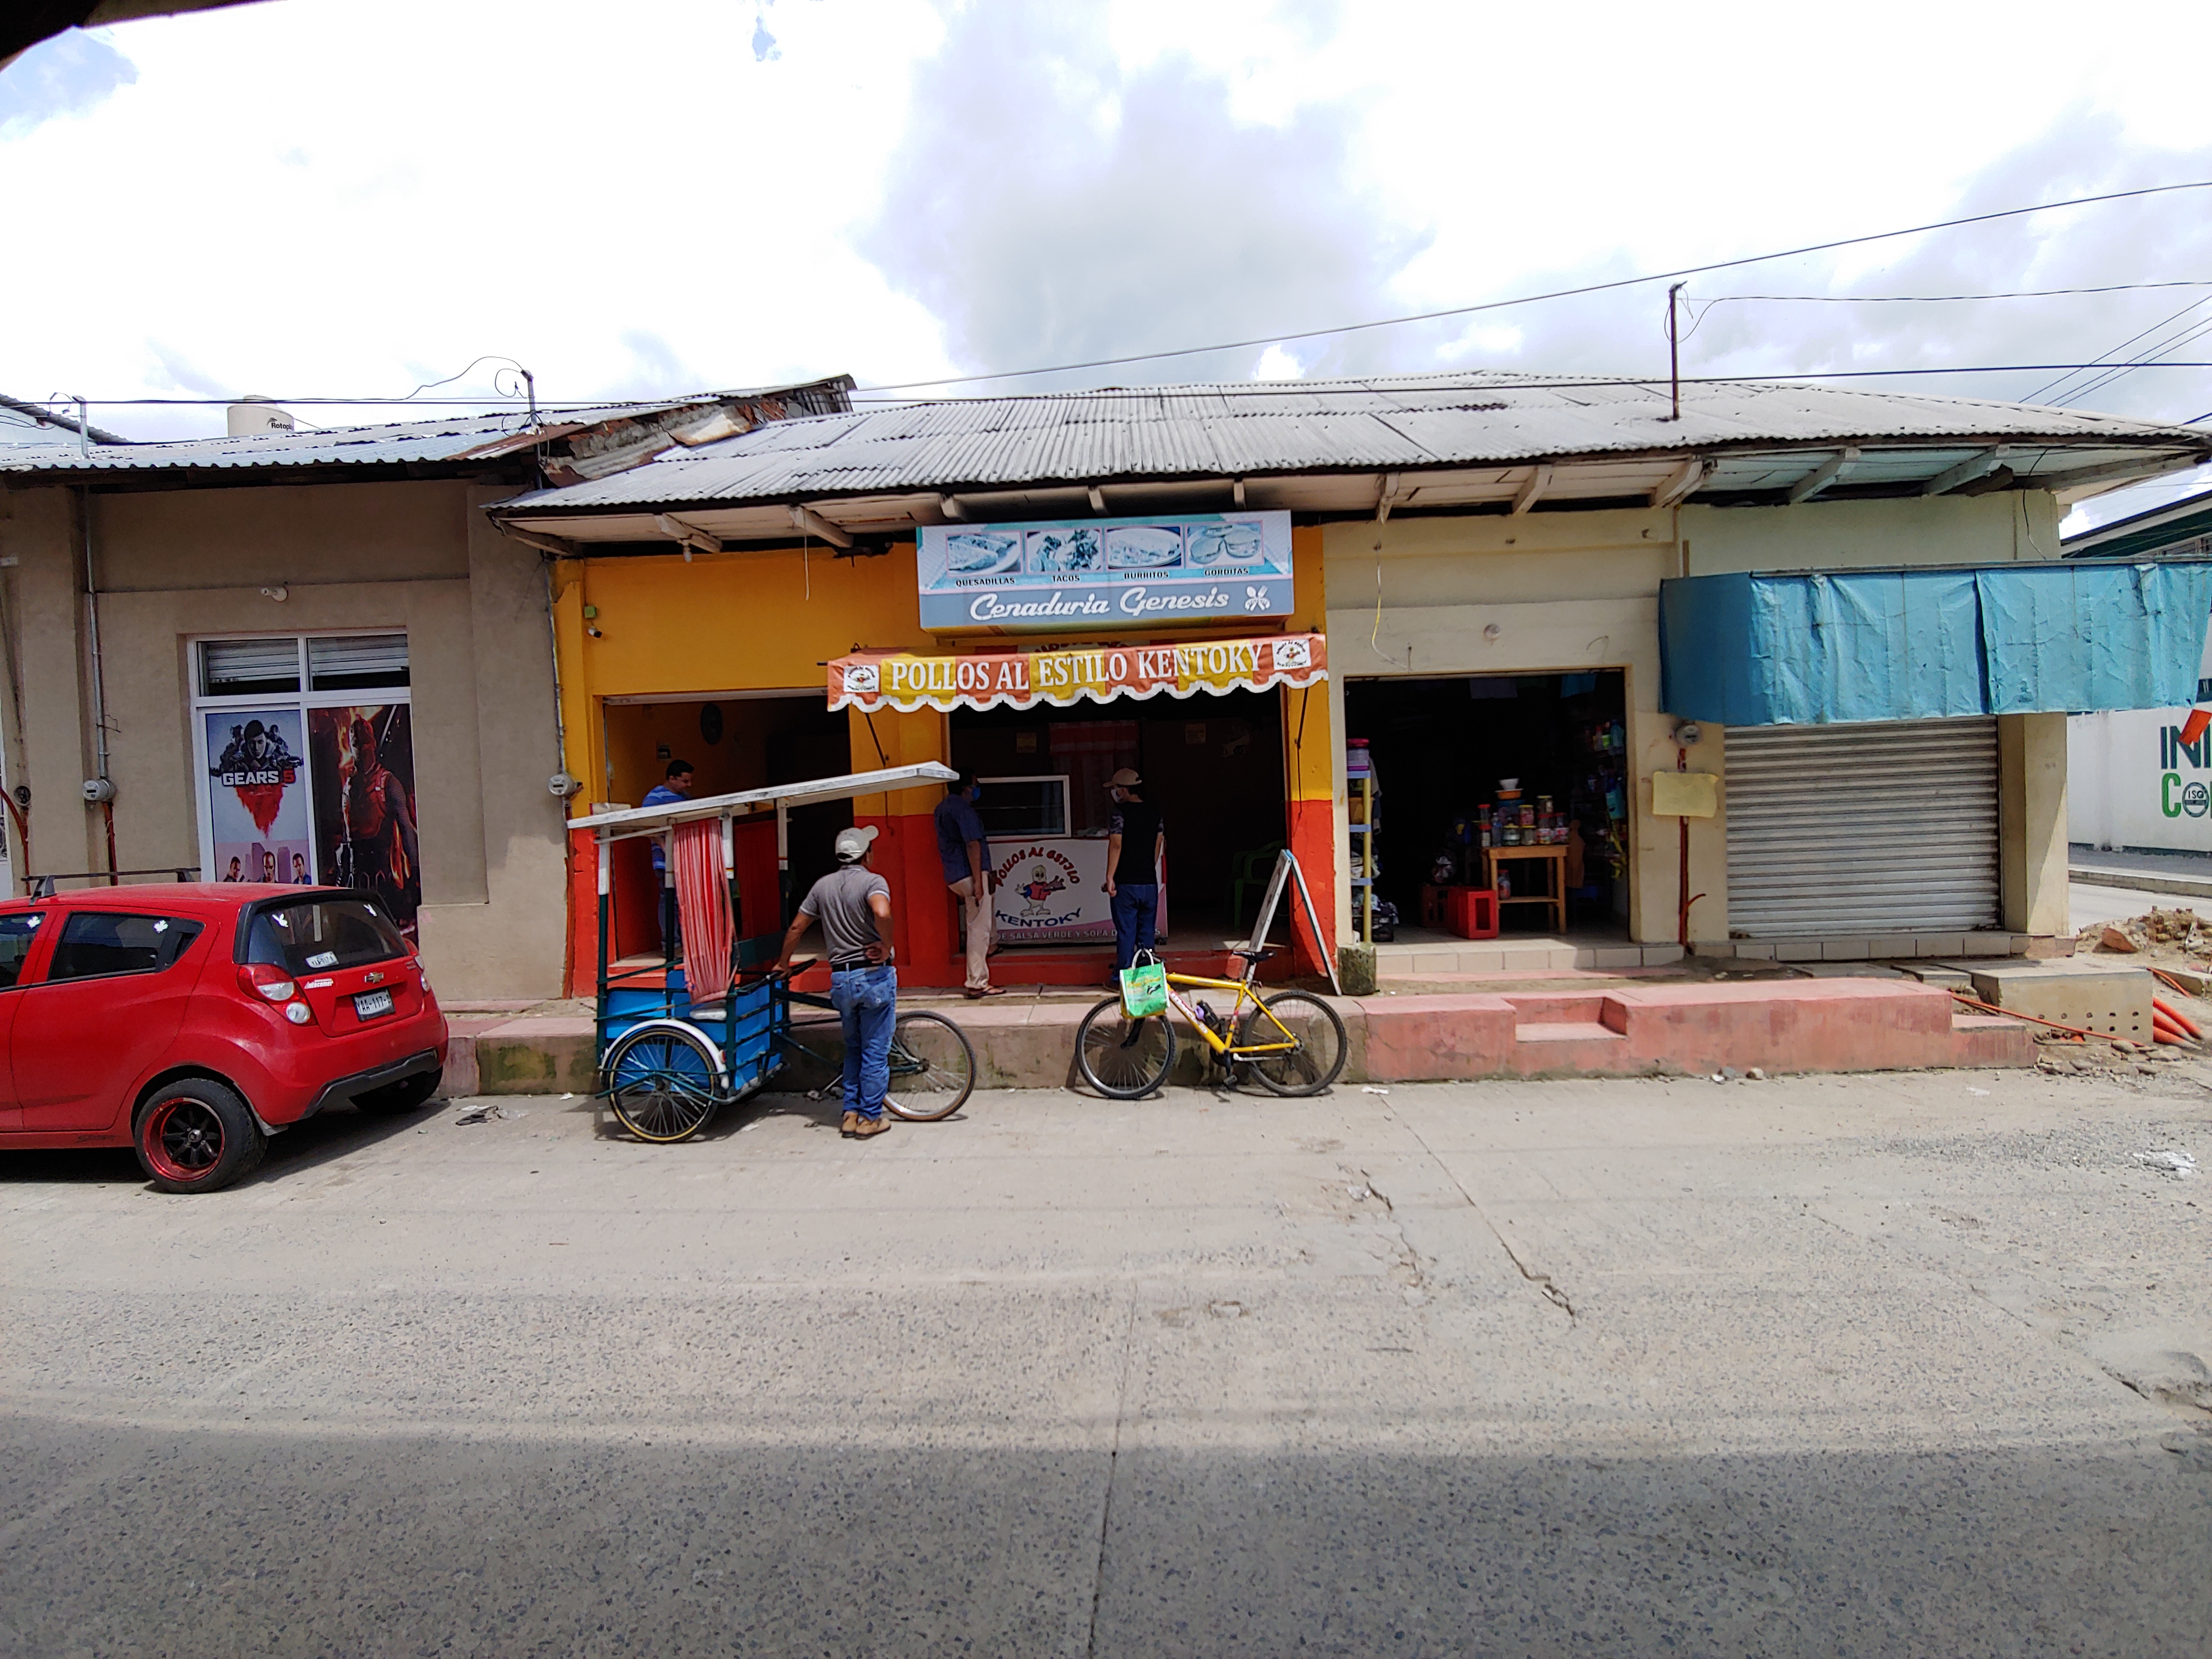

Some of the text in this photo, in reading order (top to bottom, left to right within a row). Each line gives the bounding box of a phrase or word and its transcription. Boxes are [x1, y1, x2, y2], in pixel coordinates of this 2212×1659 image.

[1124, 572, 1169, 580] BURRITOS
[1204, 568, 1249, 576] GORDITAS
[956, 577, 1015, 587] QUESADILLAS
[970, 586, 1229, 621] Cenaduria Genesis
[891, 662, 990, 690] POLLOS
[995, 662, 1029, 690] AL
[1039, 653, 1127, 687] ESTILO
[1138, 643, 1263, 678] KENTOKY
[223, 770, 296, 785] GEARS 5
[2188, 790, 2204, 799] ISO
[1028, 847, 1043, 858] AL
[996, 908, 1081, 927] KENTOKY
[1010, 931, 1040, 940] SALSA
[1041, 930, 1072, 939] VERDE
[1075, 931, 1081, 939] Y
[1084, 929, 1109, 938] SOPA
